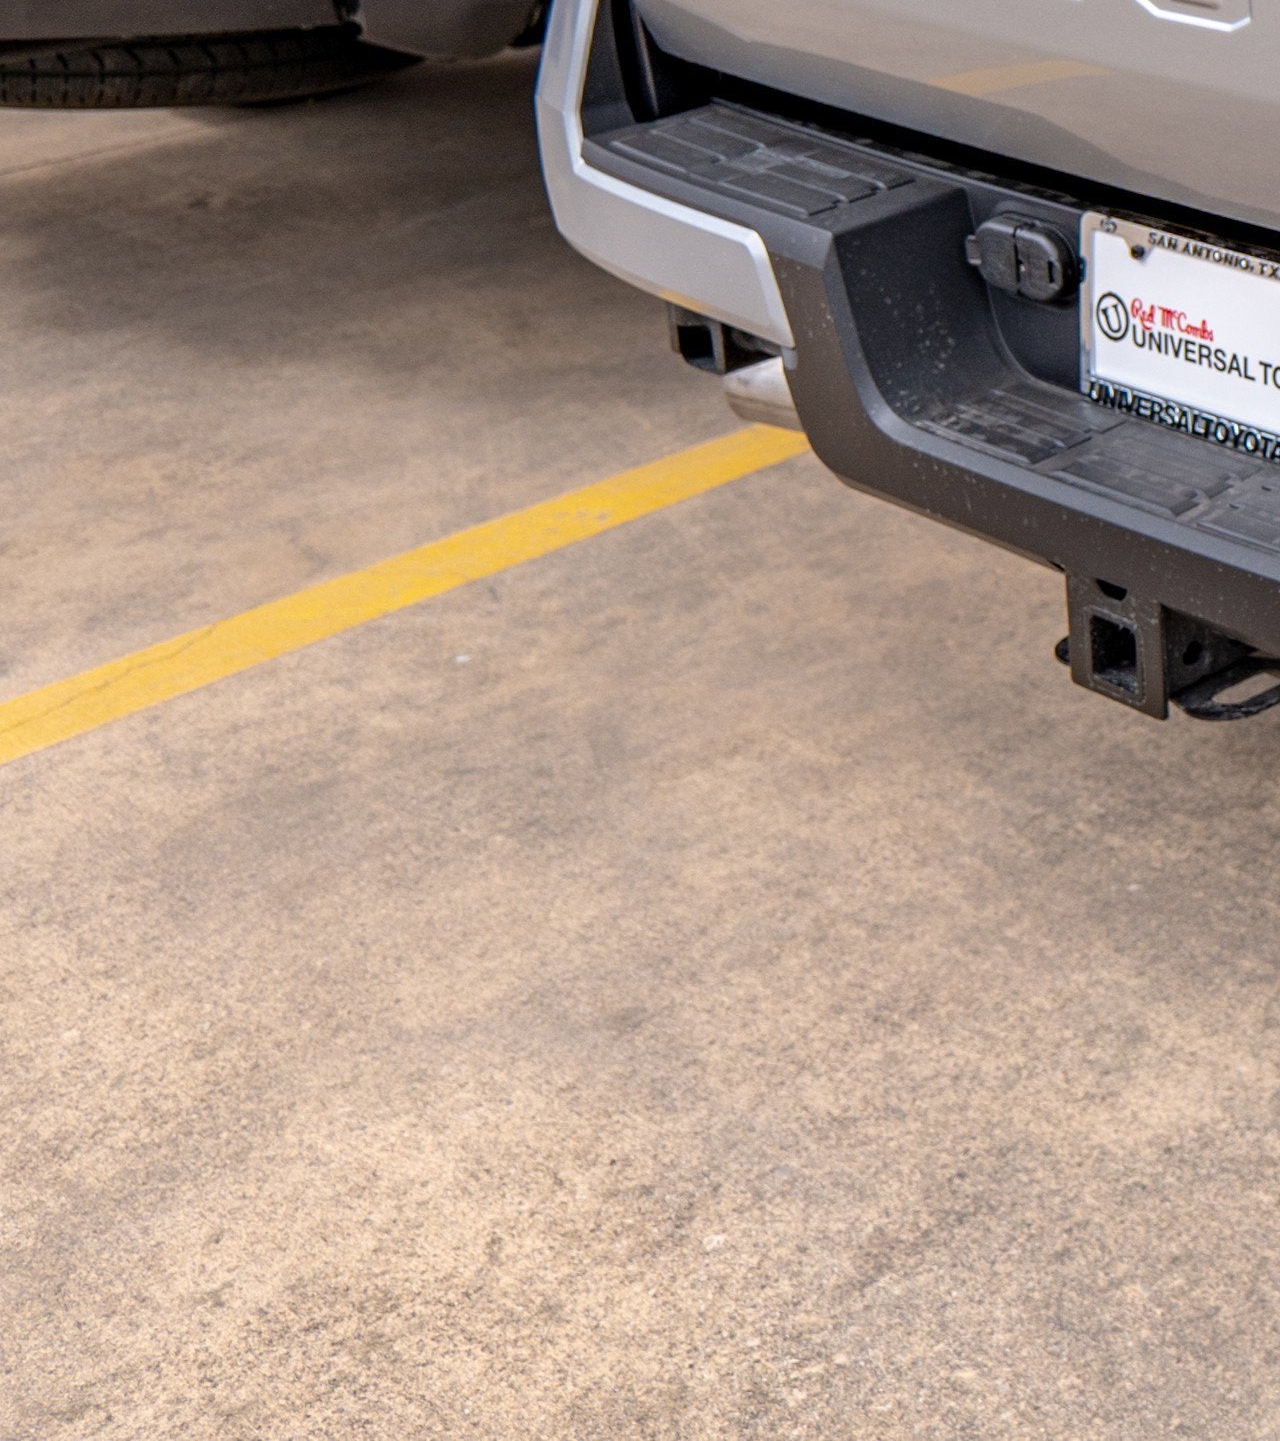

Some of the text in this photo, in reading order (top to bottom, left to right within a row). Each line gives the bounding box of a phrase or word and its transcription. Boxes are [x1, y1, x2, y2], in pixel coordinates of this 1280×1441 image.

[1148, 232, 1178, 251] SAN
[1130, 298, 1156, 331] Red
[1132, 324, 1256, 382] UNIVERSAL
